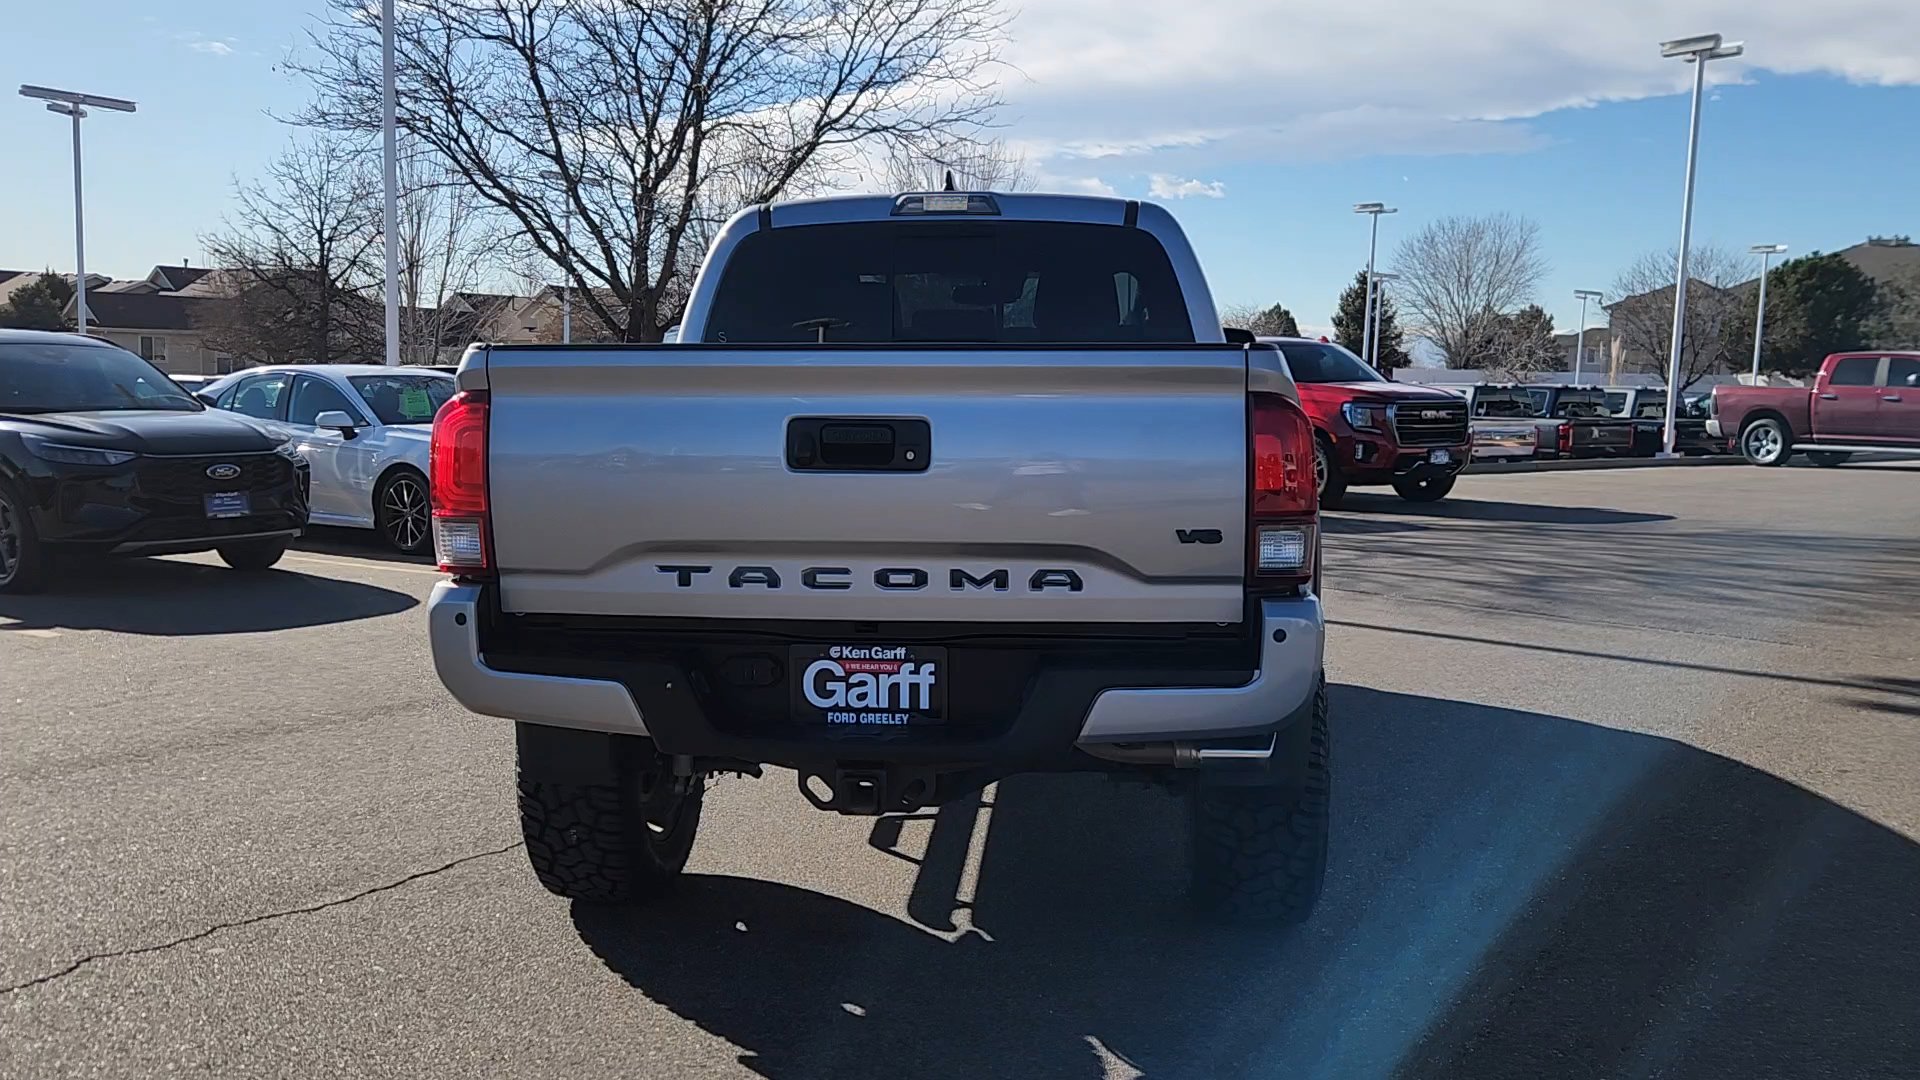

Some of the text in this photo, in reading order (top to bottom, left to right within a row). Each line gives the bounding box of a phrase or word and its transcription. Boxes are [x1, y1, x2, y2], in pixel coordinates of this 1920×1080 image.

[655, 564, 1084, 592] TACOMA
[842, 646, 906, 660] Ken Garff
[803, 659, 936, 709] Garff
[828, 712, 909, 725] FORD GREELEY
